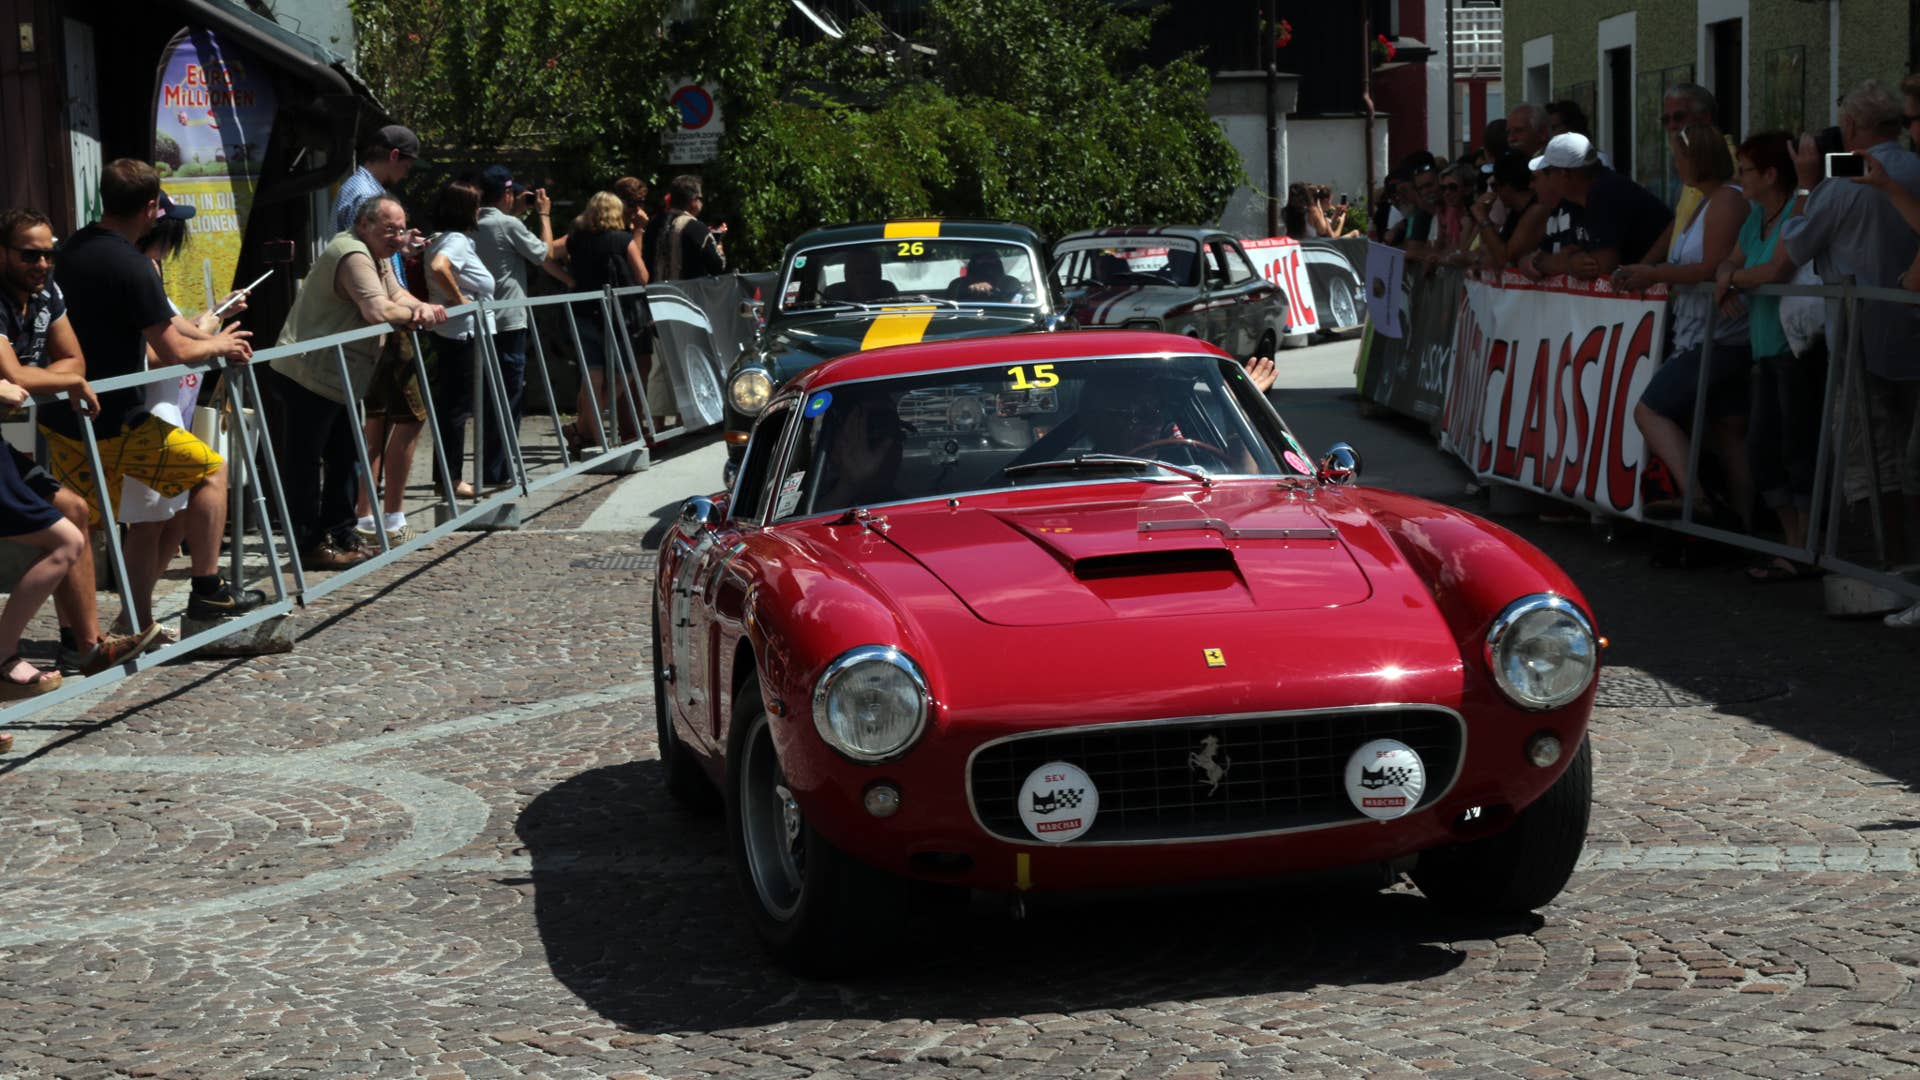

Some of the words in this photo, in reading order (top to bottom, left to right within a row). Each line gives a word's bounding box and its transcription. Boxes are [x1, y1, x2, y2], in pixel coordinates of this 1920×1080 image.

[186, 64, 233, 86] EURO
[201, 192, 215, 210] IN
[187, 213, 241, 233] LIONEN
[897, 242, 924, 256] 26
[1007, 364, 1059, 390] 15
[1045, 774, 1065, 782] SEV
